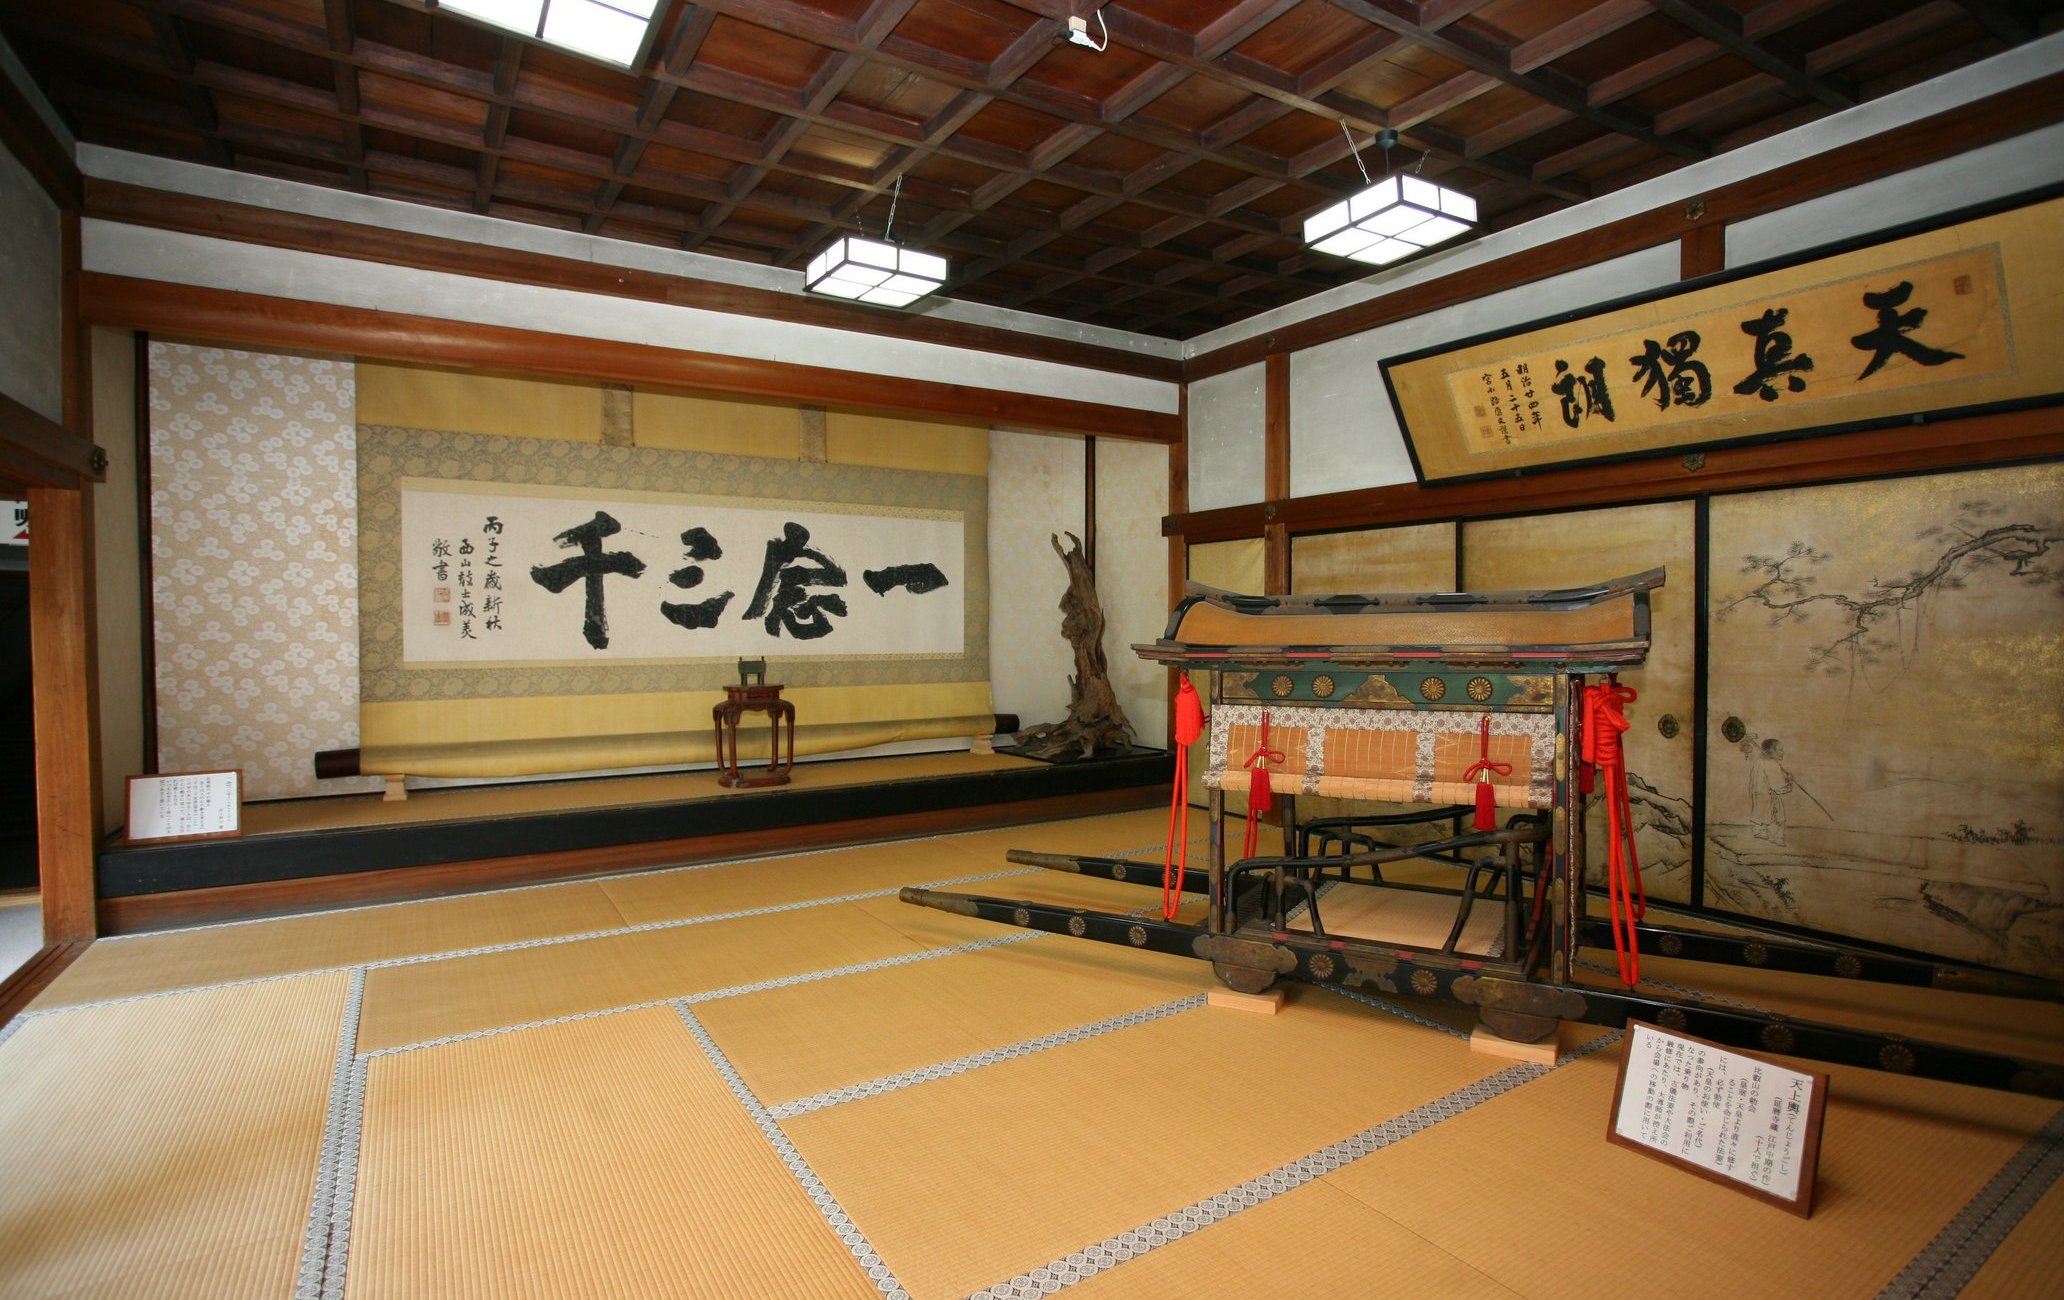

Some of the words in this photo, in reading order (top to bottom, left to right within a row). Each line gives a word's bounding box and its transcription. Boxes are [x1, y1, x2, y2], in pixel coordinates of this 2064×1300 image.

[1500, 368, 1525, 431] 五月二十五日
[530, 510, 950, 650] 一念三千
[1645, 1034, 1654, 1049] いる
[1679, 1046, 1695, 1091] なった乗り物
